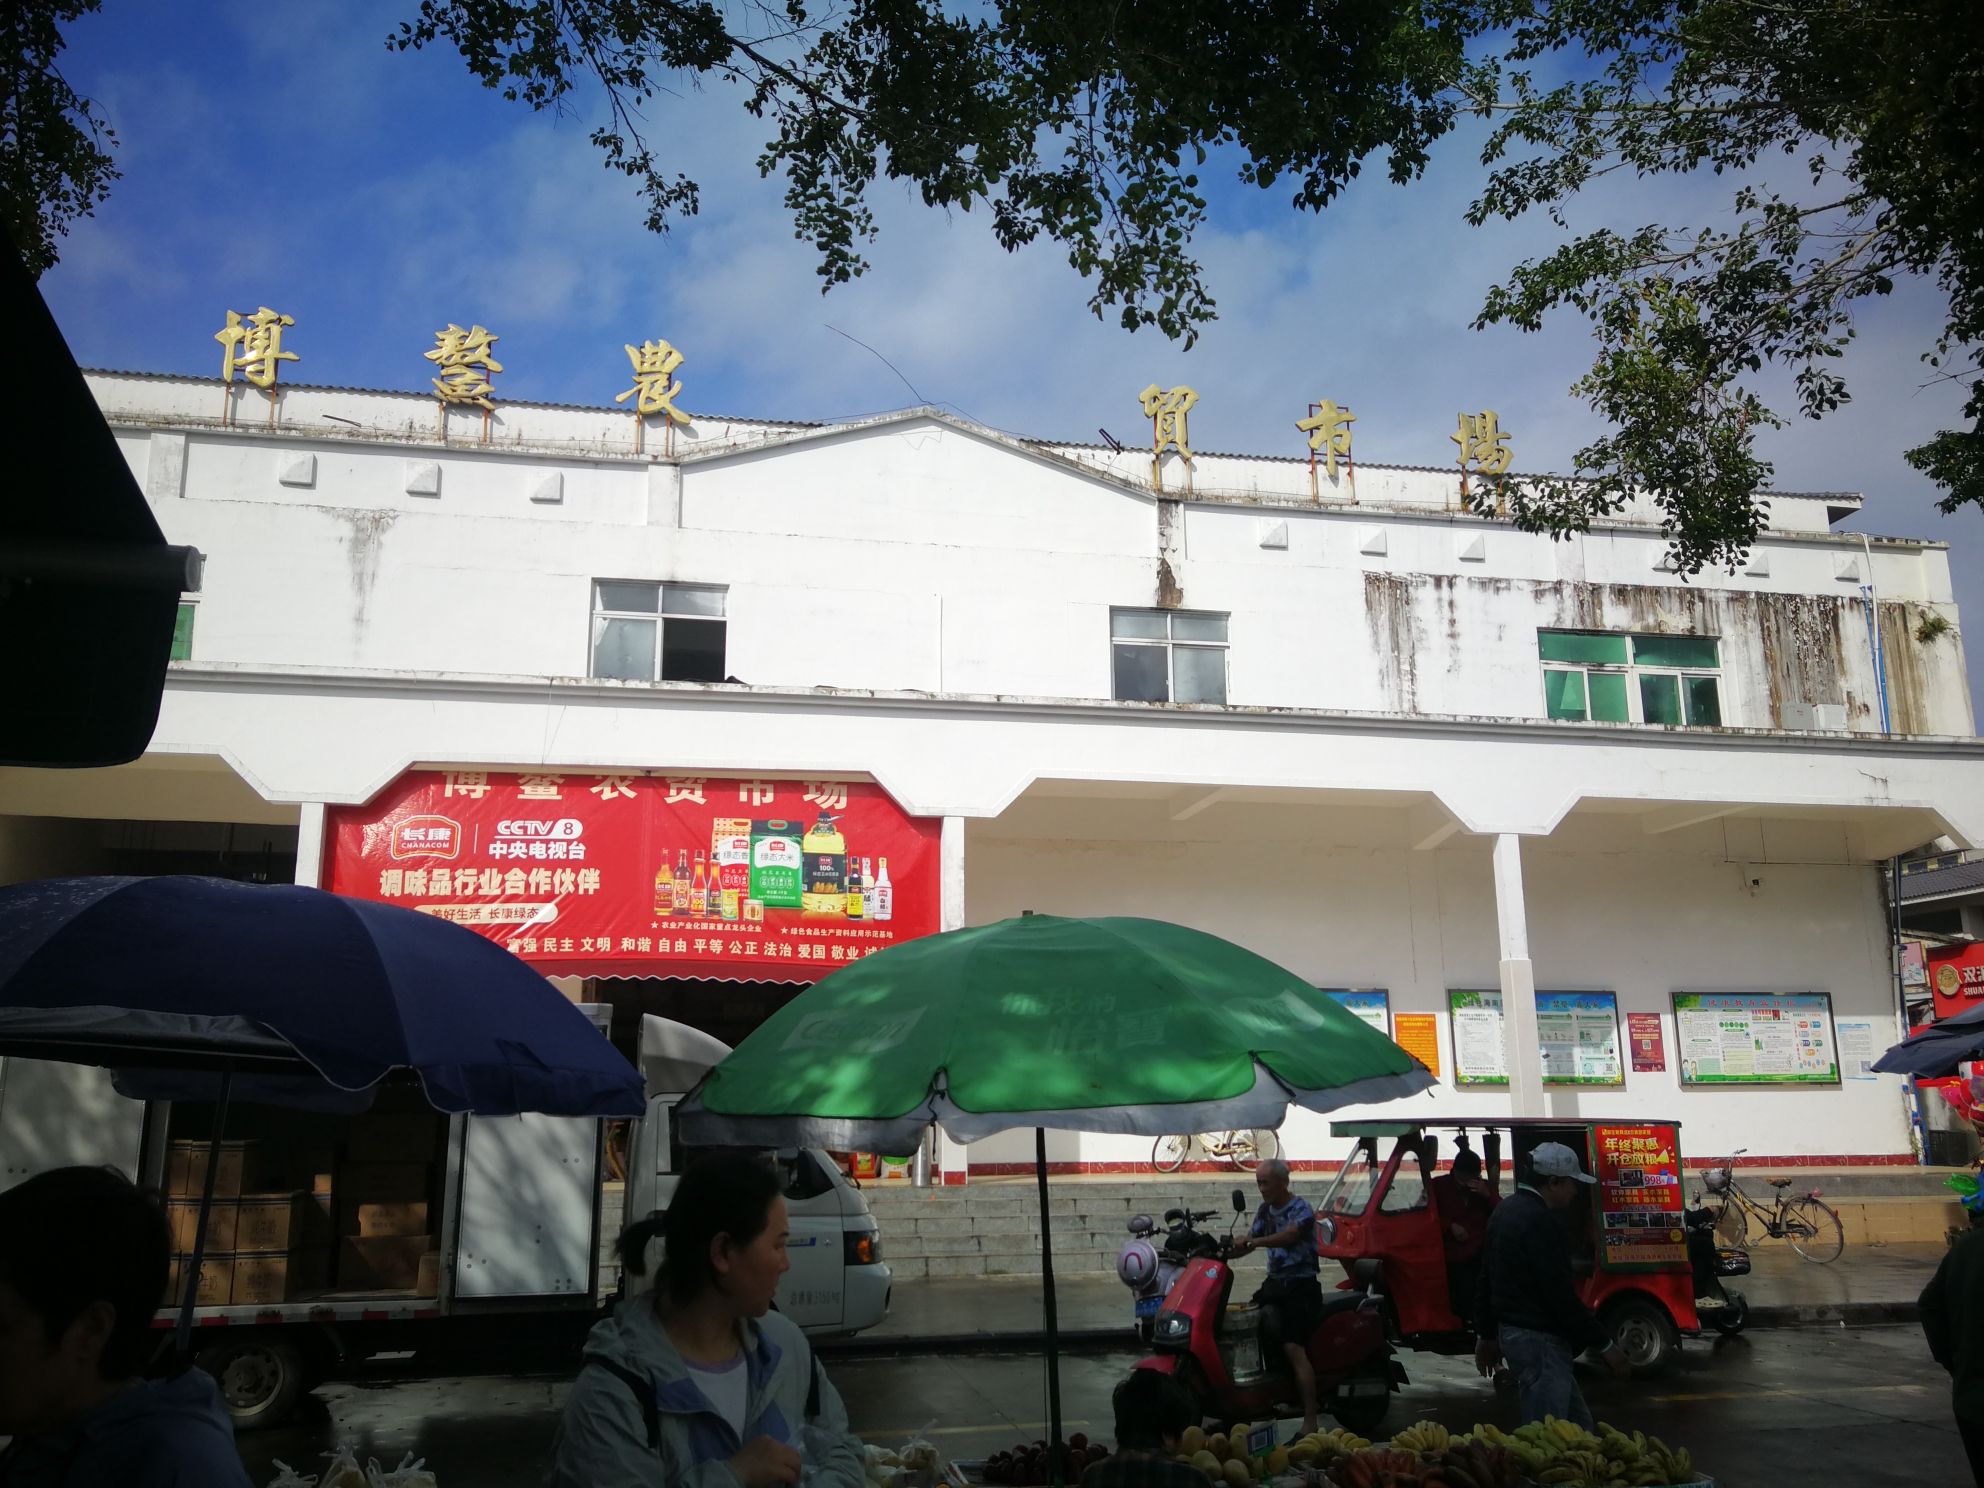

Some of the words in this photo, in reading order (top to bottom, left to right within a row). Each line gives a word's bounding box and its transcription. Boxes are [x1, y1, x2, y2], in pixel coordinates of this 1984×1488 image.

[401, 828, 451, 840] 长康
[488, 841, 586, 860] 中央电视台
[380, 868, 600, 897] 调味品行业合作伙伴
[488, 908, 539, 920] 长康绿态
[507, 938, 538, 953] 富强
[544, 938, 574, 952] 民主
[580, 937, 611, 952] 文明
[621, 938, 651, 953] 和谐
[658, 939, 687, 953] 自由
[693, 939, 723, 953] 平等
[729, 941, 758, 955] 公正
[763, 941, 793, 957] 法治
[797, 943, 826, 959] 爱国
[831, 945, 859, 960] 敬业
